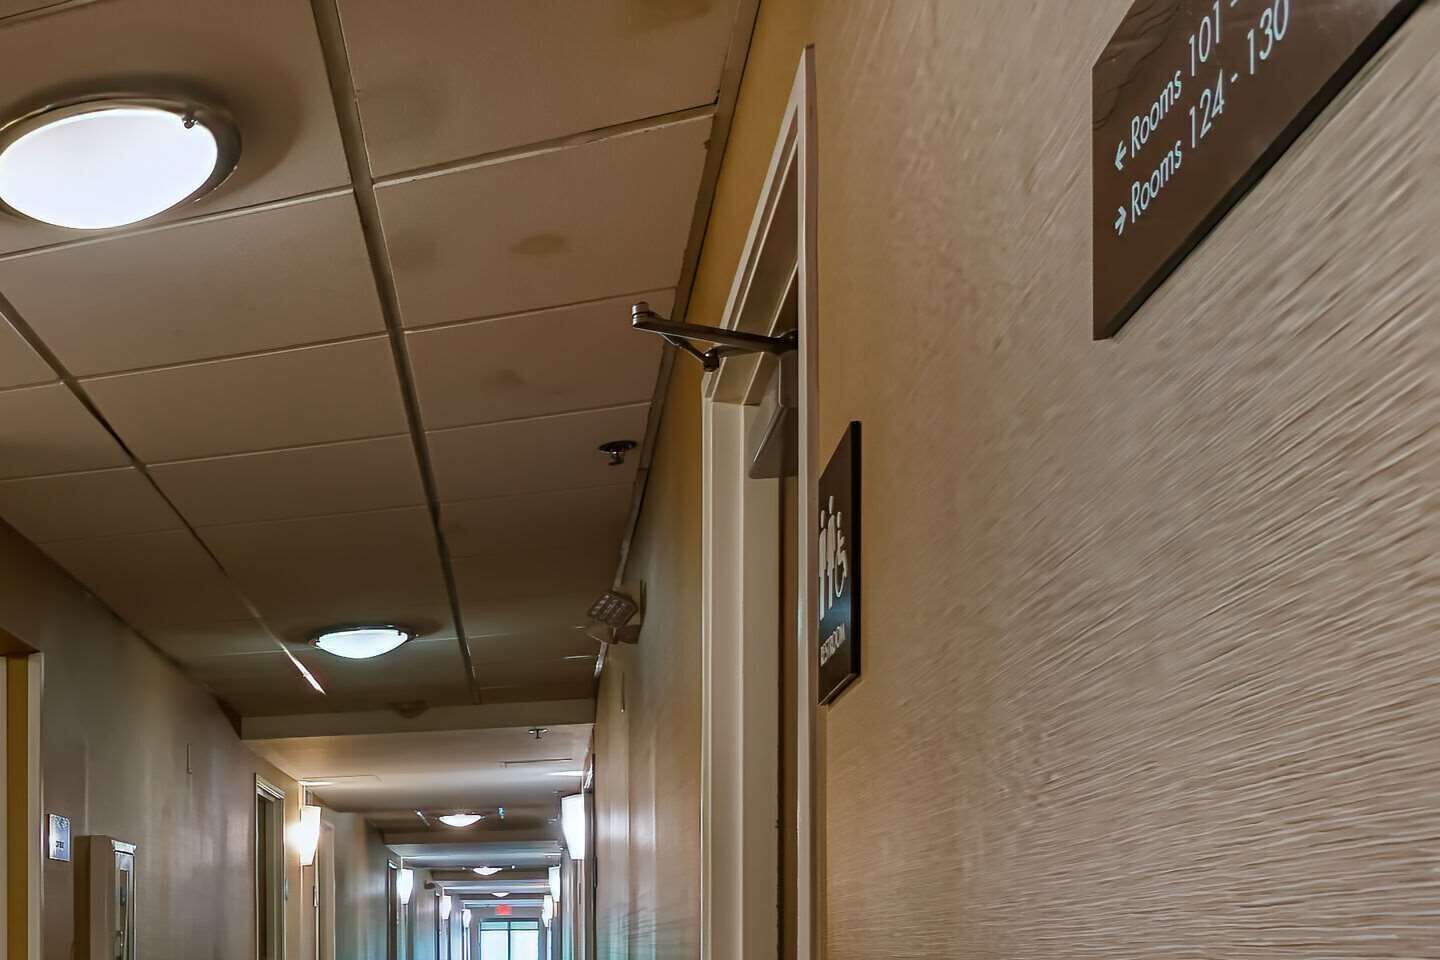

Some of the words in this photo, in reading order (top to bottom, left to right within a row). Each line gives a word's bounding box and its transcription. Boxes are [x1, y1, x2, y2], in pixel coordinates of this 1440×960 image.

[1131, 70, 1182, 157] Rooms
[1189, 0, 1221, 76] 101
[1131, 140, 1182, 223] Rooms
[1189, 69, 1225, 148] 124
[1247, 0, 1289, 75] 130
